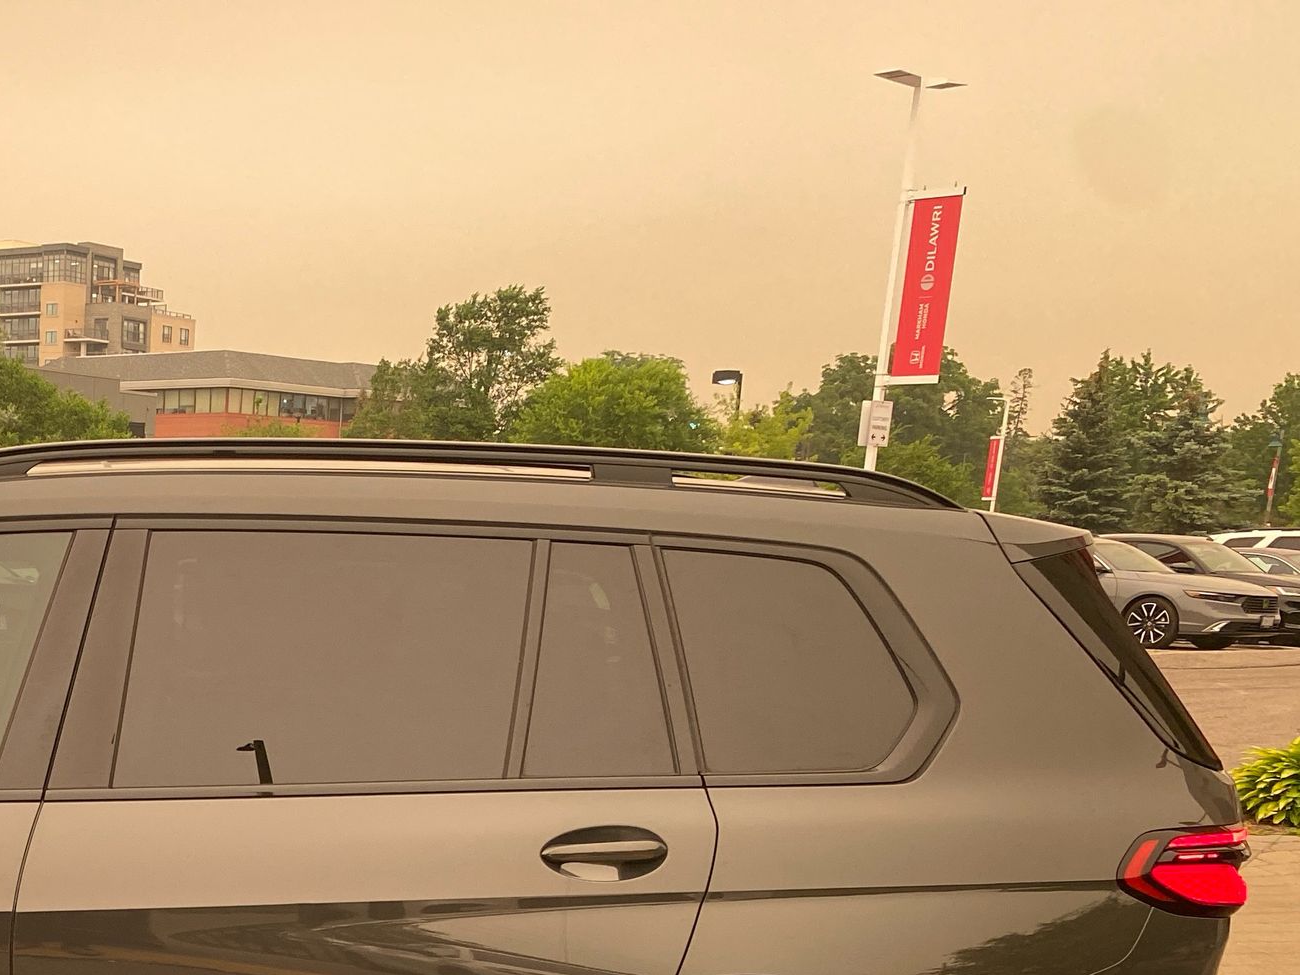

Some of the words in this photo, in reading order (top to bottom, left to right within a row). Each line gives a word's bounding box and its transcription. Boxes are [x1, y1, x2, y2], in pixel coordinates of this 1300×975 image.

[924, 205, 943, 272] DILAWRI
[914, 303, 924, 340] MARKHAM
[921, 302, 930, 329] HONDA
